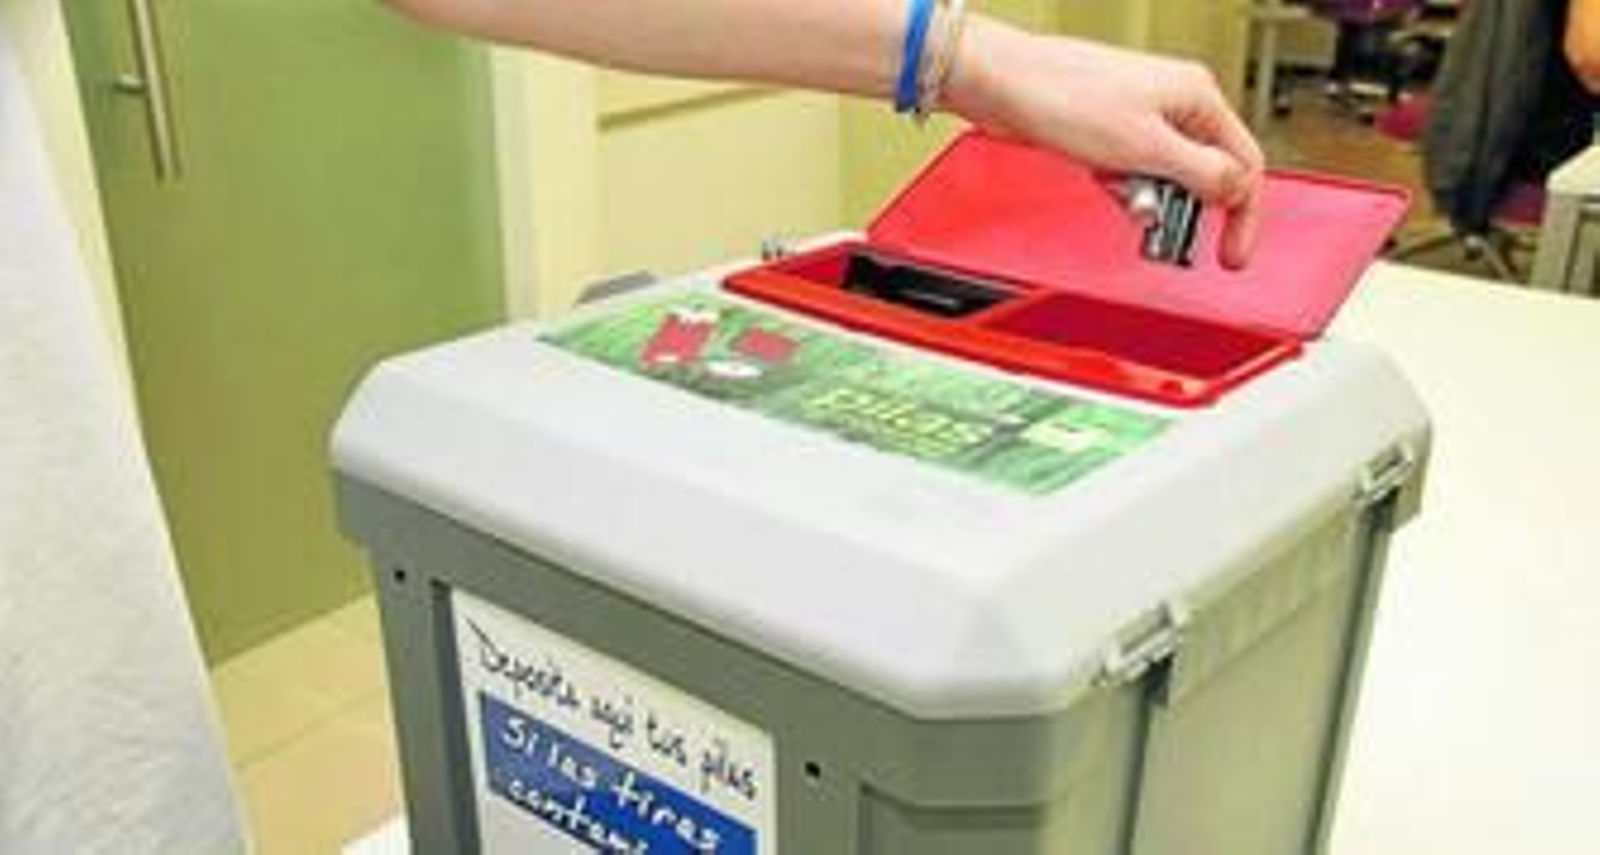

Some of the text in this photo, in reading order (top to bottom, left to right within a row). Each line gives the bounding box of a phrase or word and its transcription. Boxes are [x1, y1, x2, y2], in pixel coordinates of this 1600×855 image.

[503, 718, 540, 758] Si
[609, 771, 722, 853] tires
[647, 708, 687, 767] tus
